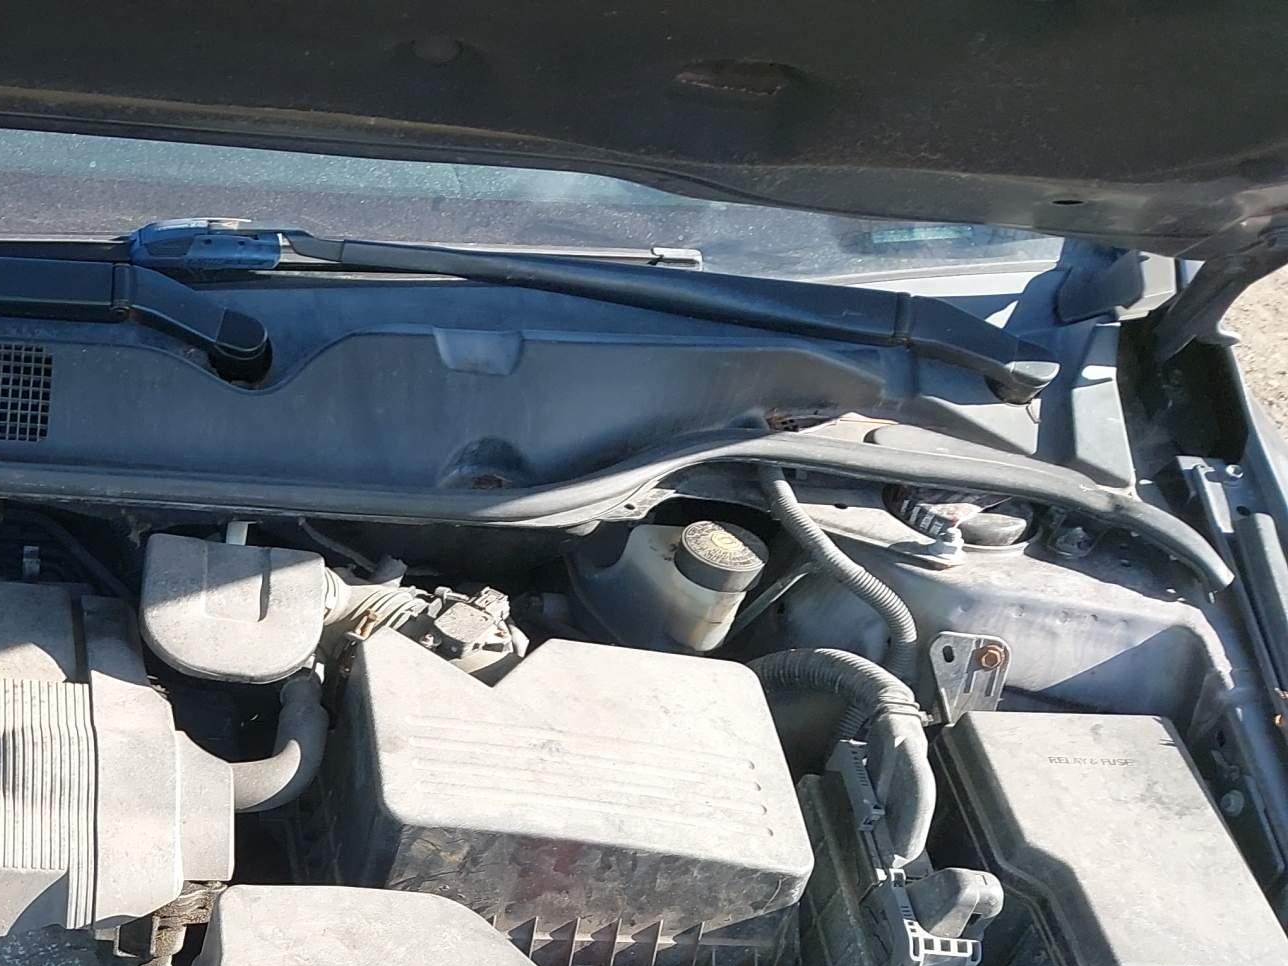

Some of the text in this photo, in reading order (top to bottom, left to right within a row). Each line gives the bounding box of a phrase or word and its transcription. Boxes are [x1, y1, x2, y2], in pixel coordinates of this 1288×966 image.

[1048, 756, 1135, 767] RELAY & FUSE
